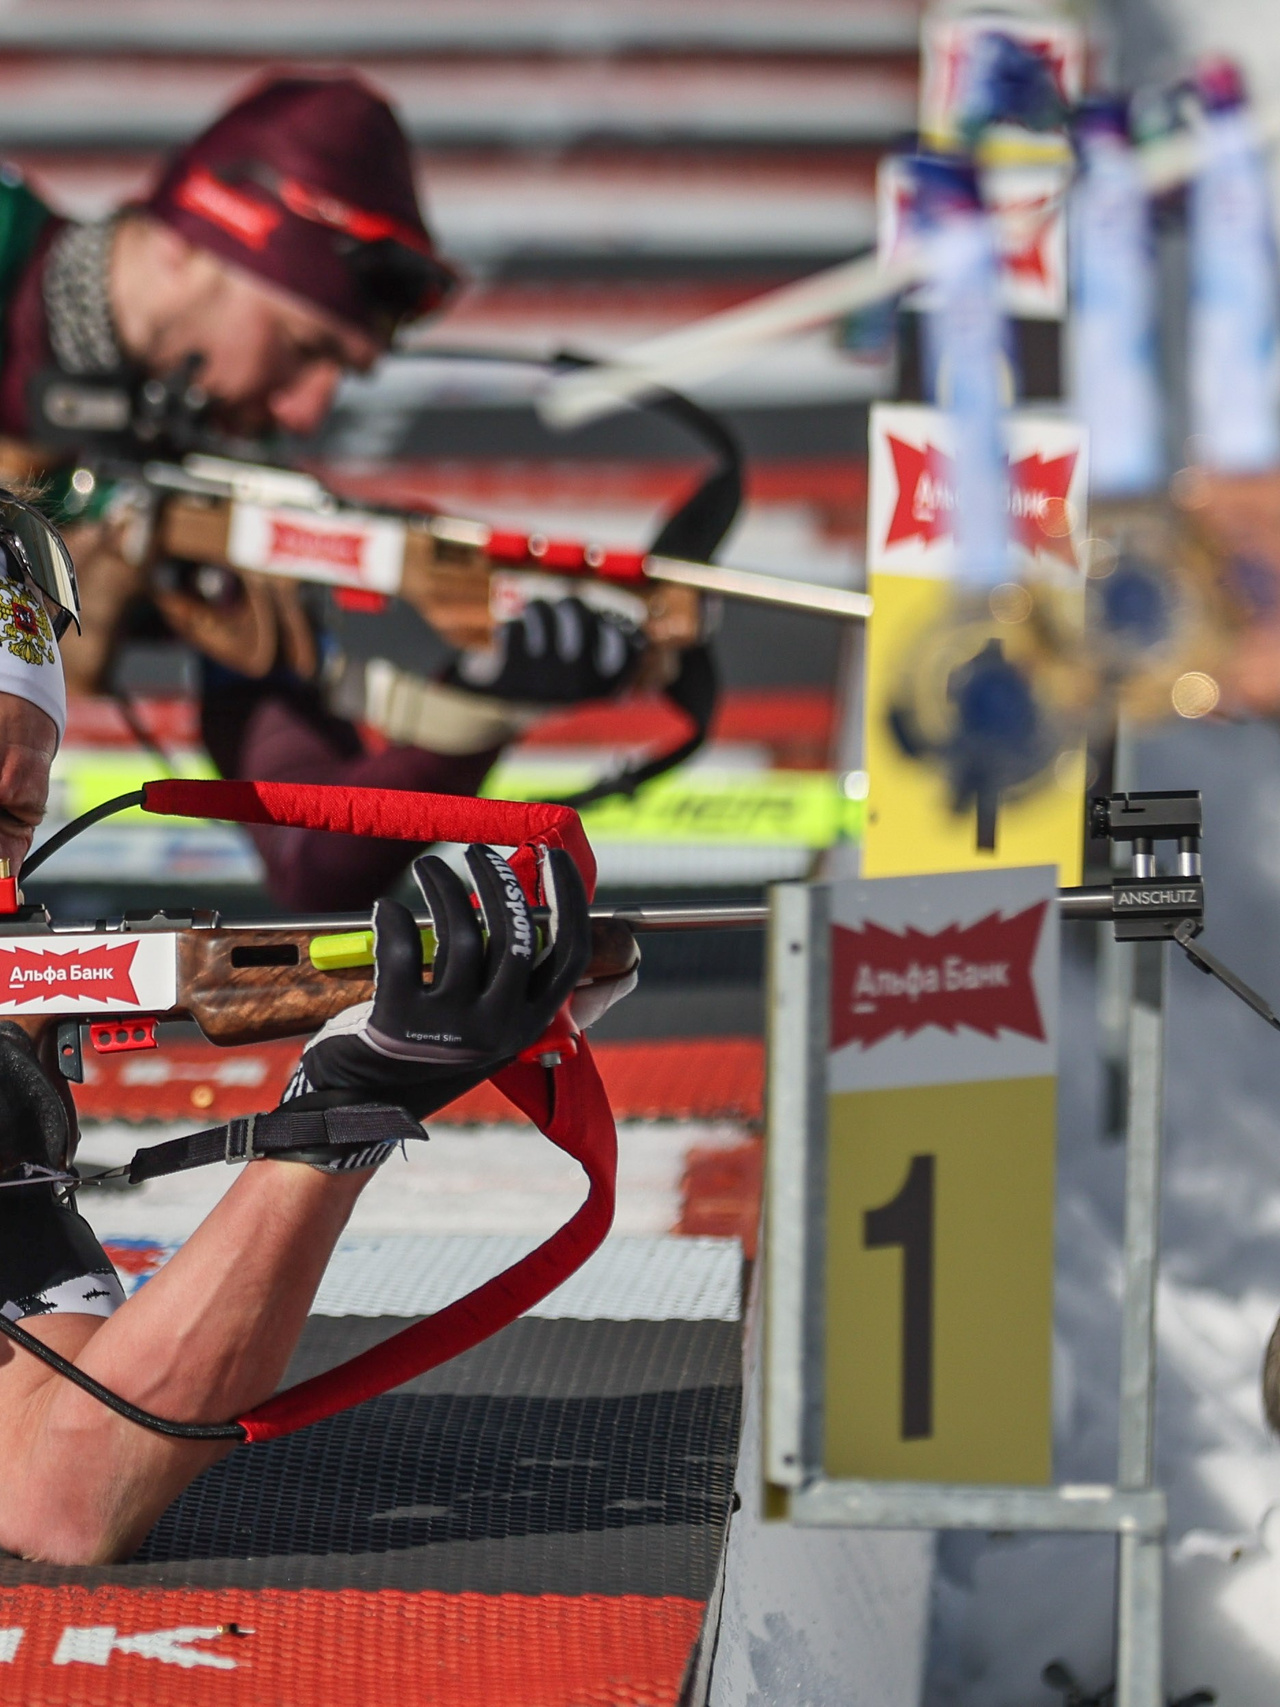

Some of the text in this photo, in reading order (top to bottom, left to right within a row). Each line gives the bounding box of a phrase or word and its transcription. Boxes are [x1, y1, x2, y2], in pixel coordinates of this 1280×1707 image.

[9, 964, 114, 985] Альфа Банк
[852, 955, 1011, 1006] Альфа Банк
[405, 1030, 462, 1043] Legend Slim
[863, 1153, 935, 1440] 1
